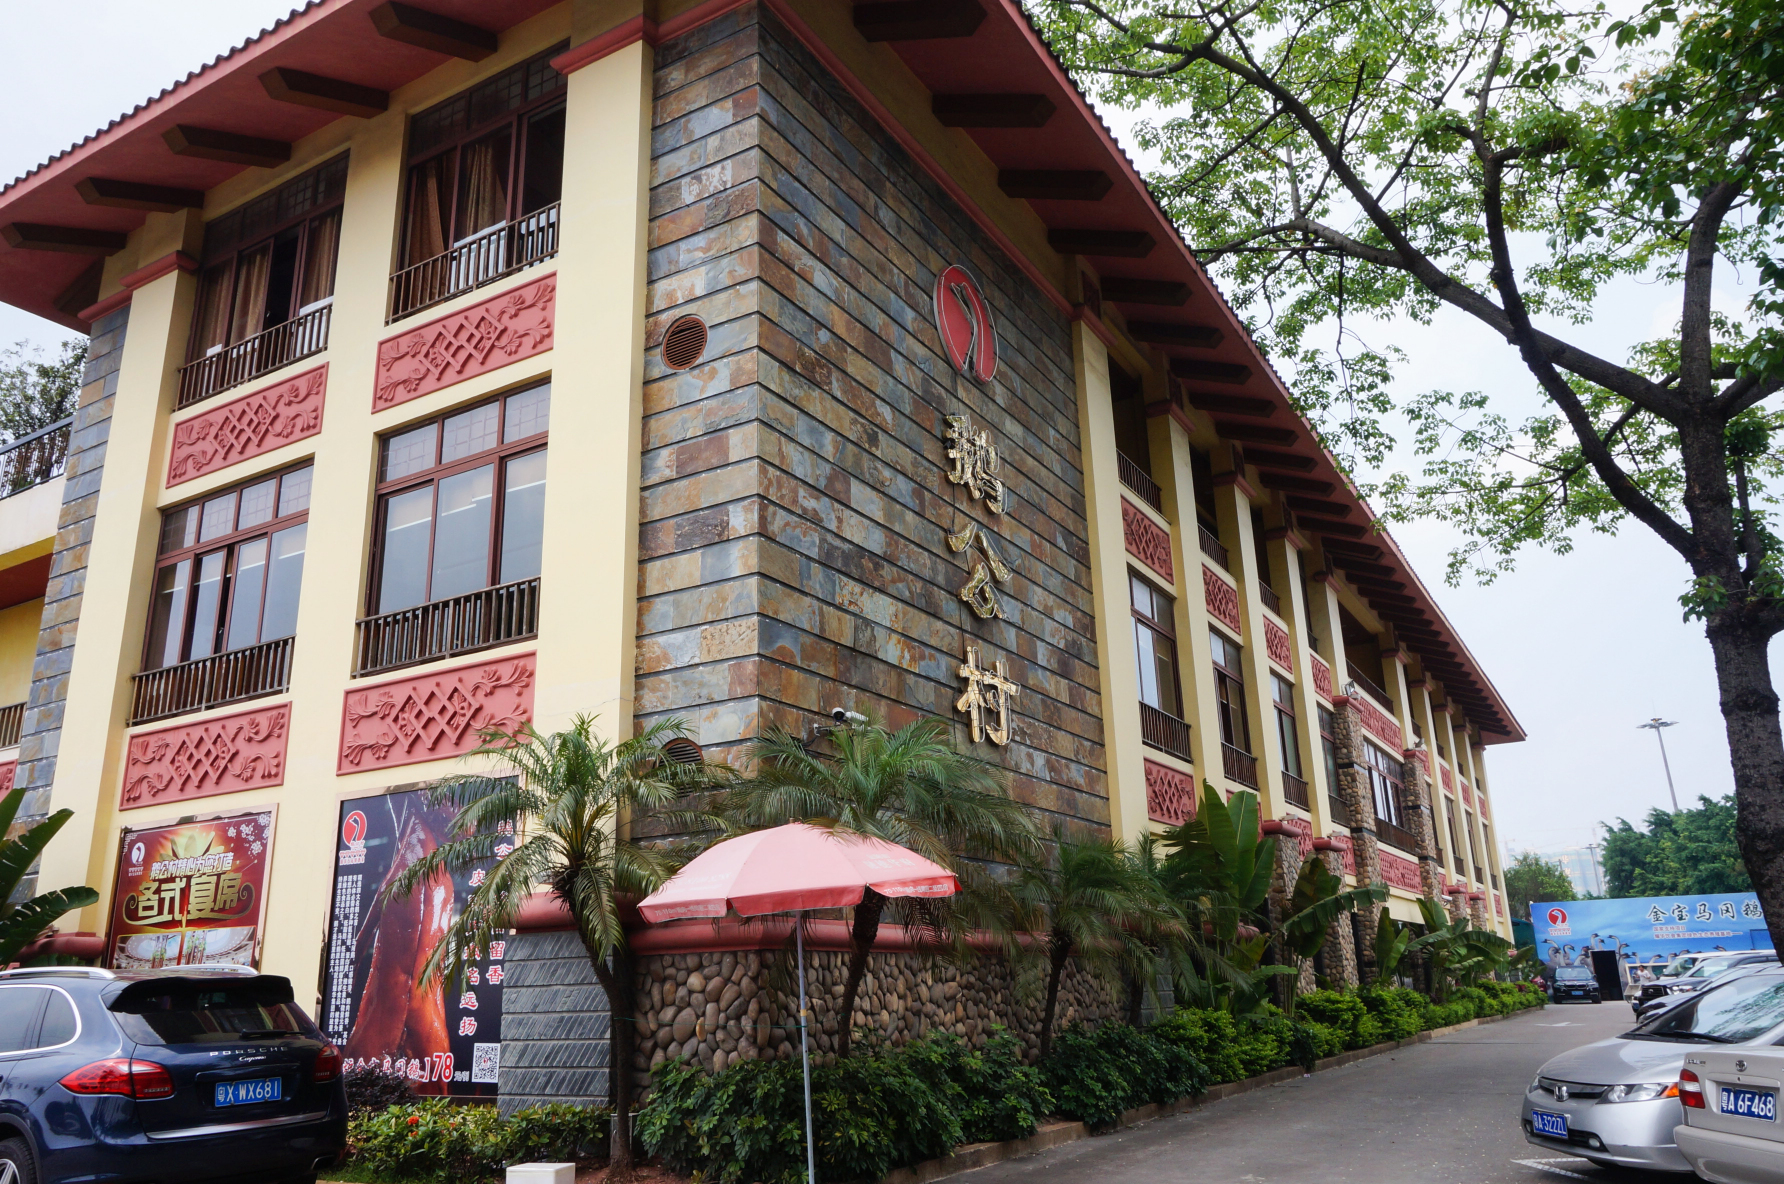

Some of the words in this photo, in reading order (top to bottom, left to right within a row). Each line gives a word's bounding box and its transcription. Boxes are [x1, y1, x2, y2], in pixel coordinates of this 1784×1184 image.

[149, 852, 234, 880] 鹅公村精心为您打造
[138, 873, 242, 920] 各式宴席
[1647, 900, 1764, 924] 金宝马冈鹅
[210, 1046, 288, 1056] PORSCHE
[432, 1052, 454, 1082] 78
